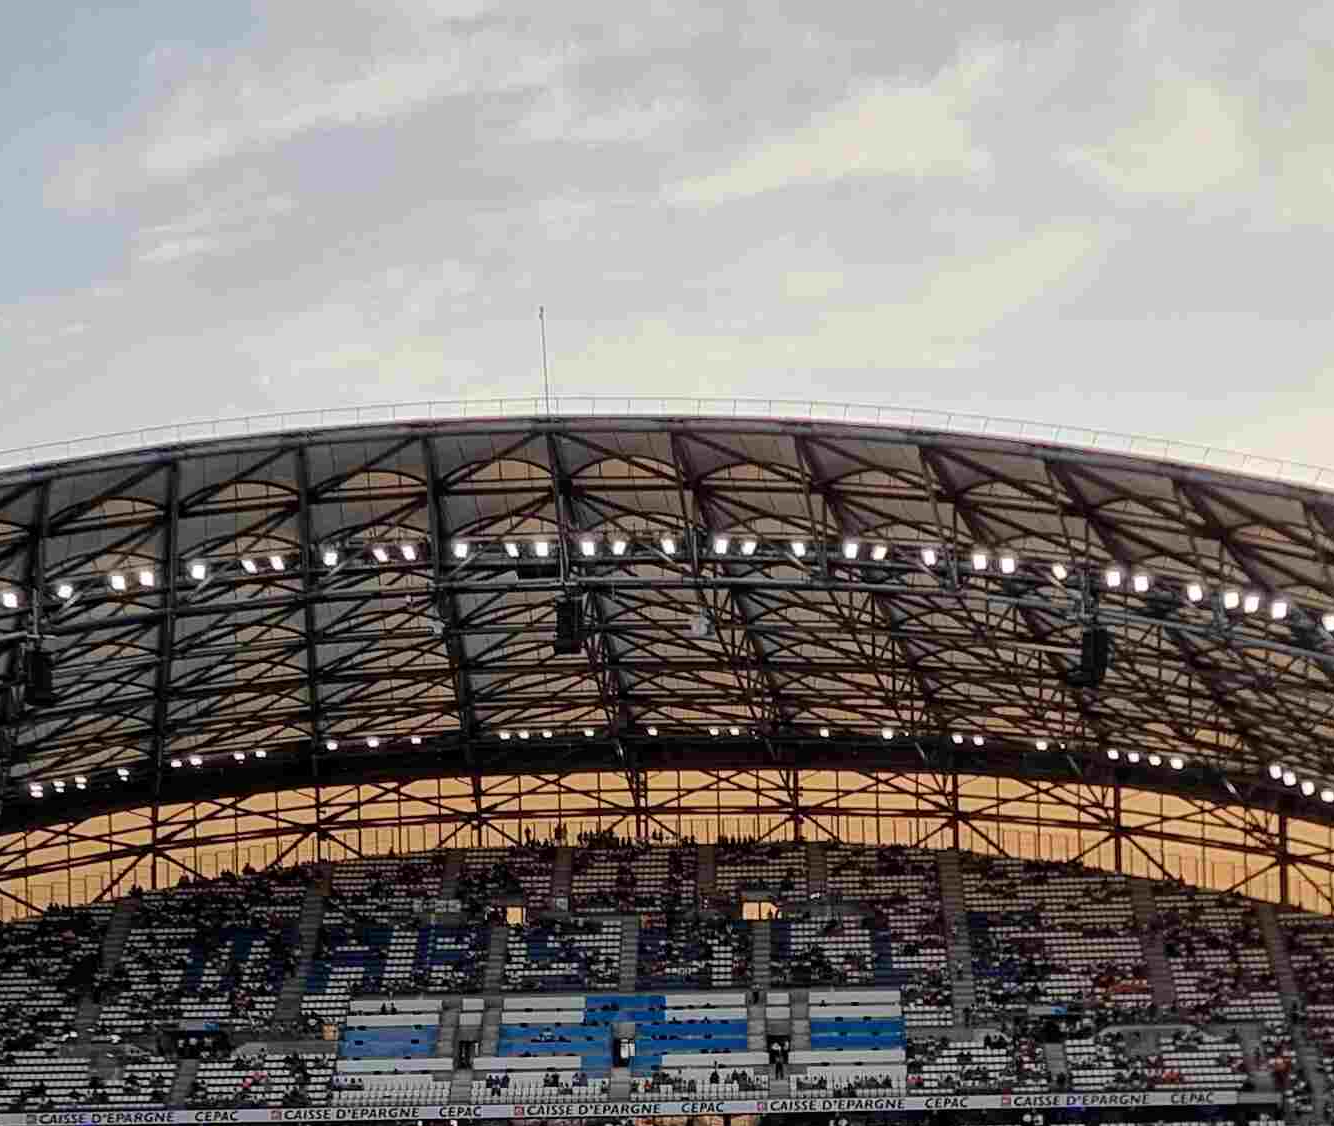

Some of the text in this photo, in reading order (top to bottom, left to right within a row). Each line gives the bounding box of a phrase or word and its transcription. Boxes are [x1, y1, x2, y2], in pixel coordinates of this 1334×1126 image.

[769, 1099, 818, 1112] CAISSE
[924, 1096, 969, 1109] CEPAC
[1013, 1095, 1062, 1107] CAISSE
[1170, 1092, 1214, 1104] CEPAC
[283, 1108, 332, 1120] CAISSE
[438, 1106, 483, 1118] CEPAC
[526, 1104, 574, 1116] CAISSE
[681, 1101, 725, 1113] CEPAC
[38, 1113, 88, 1125] CAISSE
[194, 1110, 240, 1122] CEPAC
